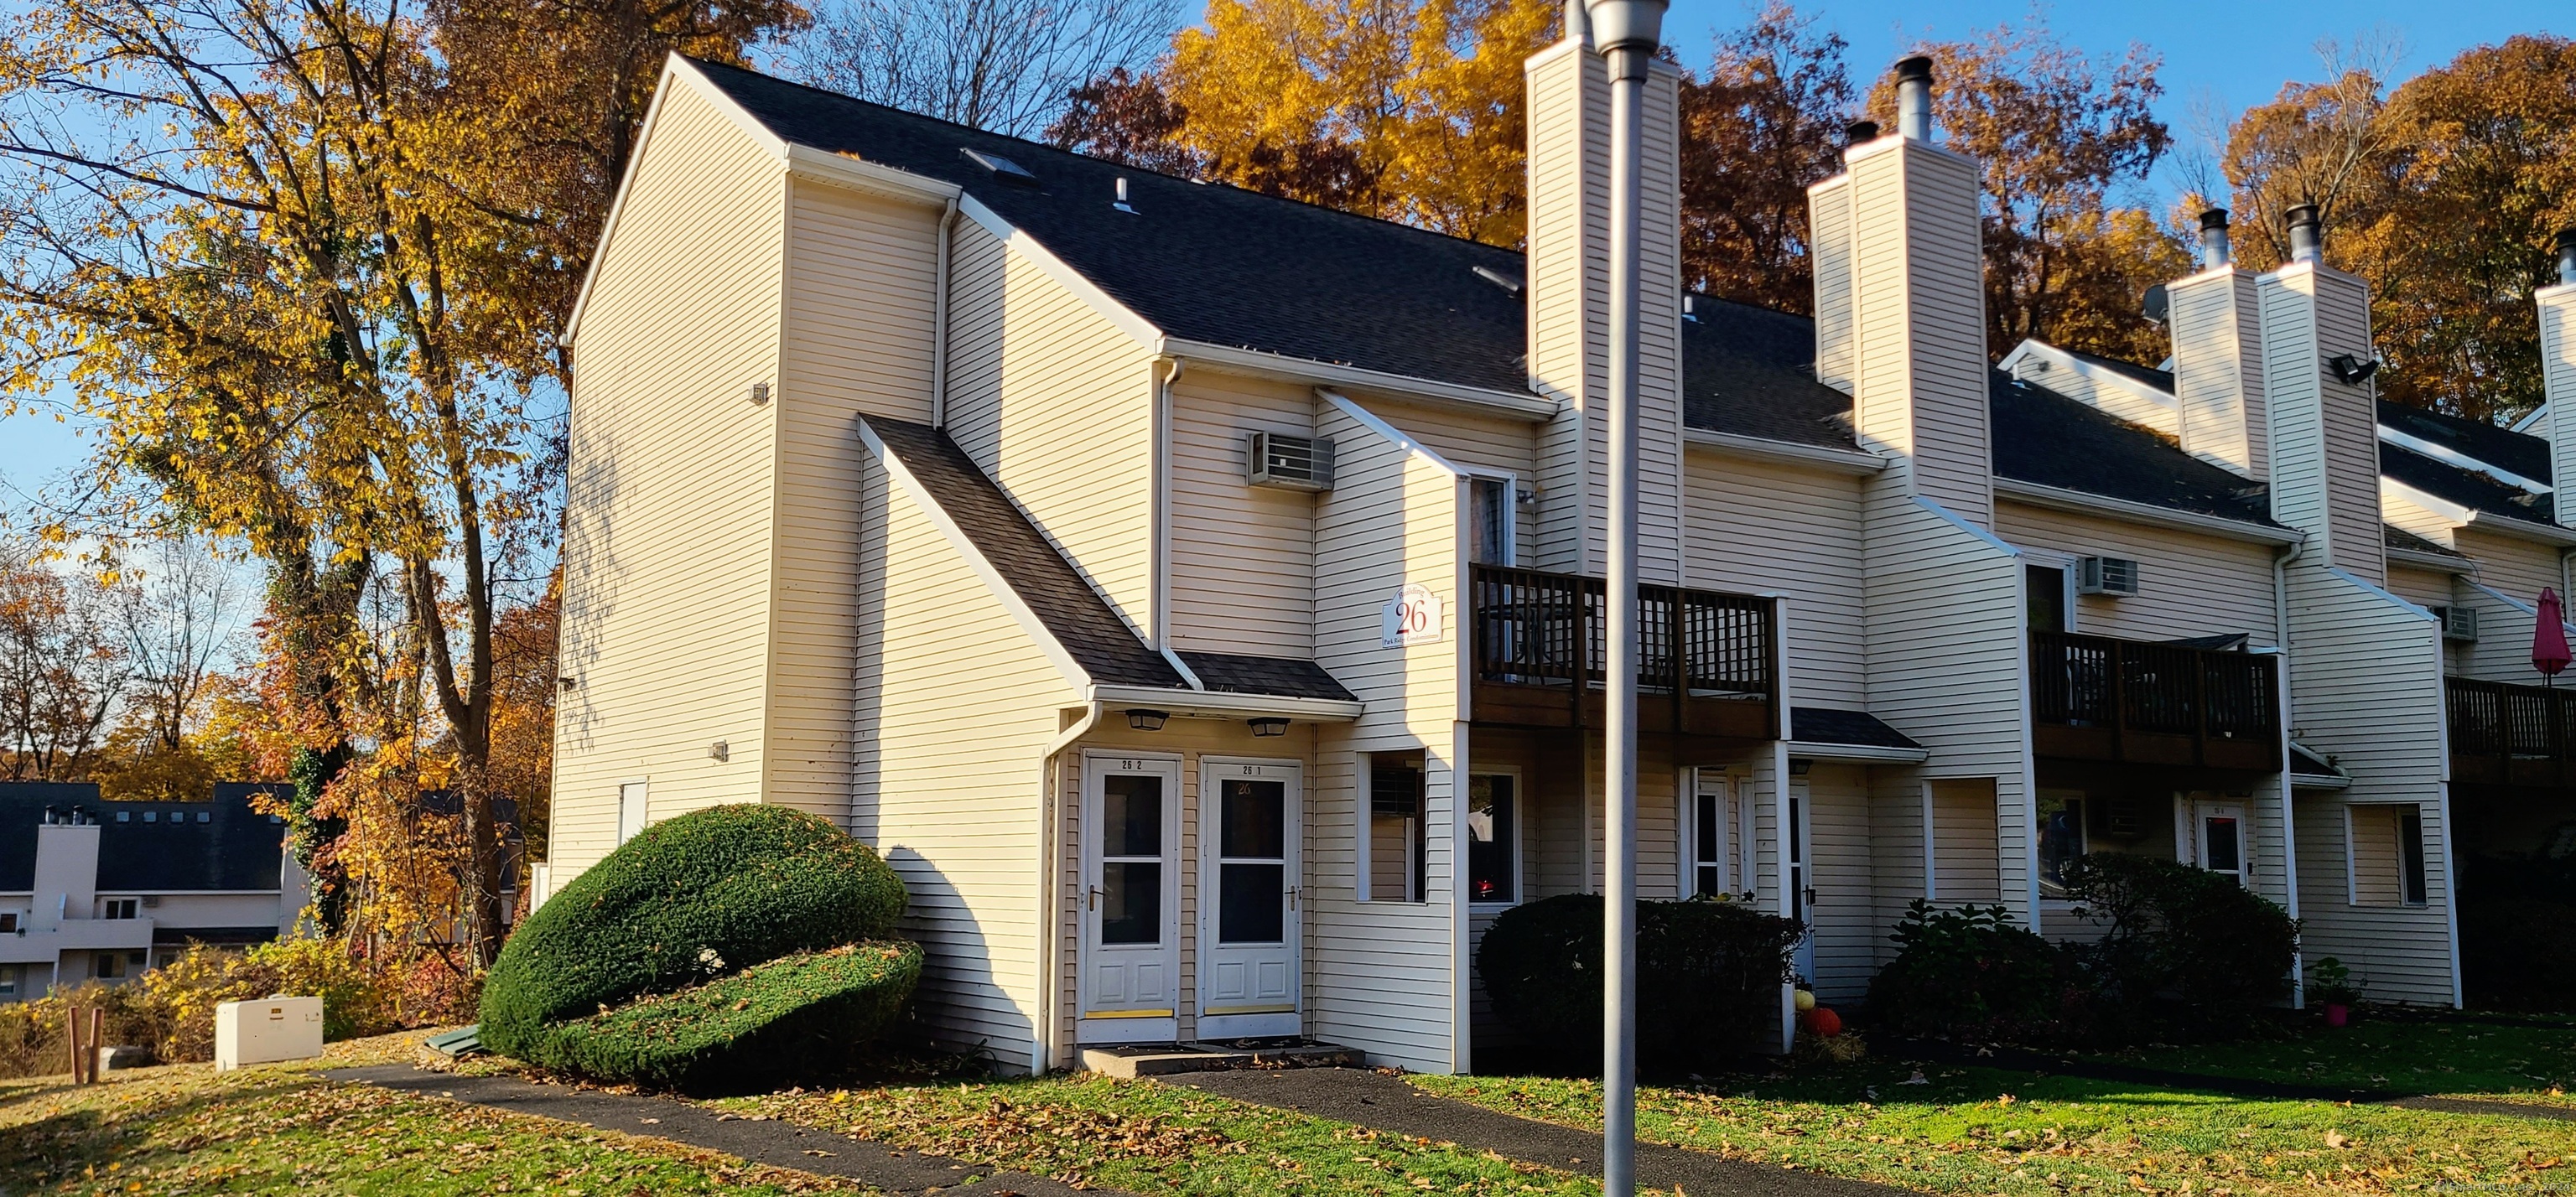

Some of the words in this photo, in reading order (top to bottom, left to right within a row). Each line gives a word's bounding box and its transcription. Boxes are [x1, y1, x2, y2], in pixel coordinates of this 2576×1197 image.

[1399, 588, 1426, 599] Building
[1396, 600, 1427, 635] 26
[1122, 760, 1132, 770] 26
[1137, 760, 1142, 770] 2
[1243, 765, 1253, 775] 26
[1257, 766, 1261, 775] 1
[1239, 783, 1251, 795] 26
